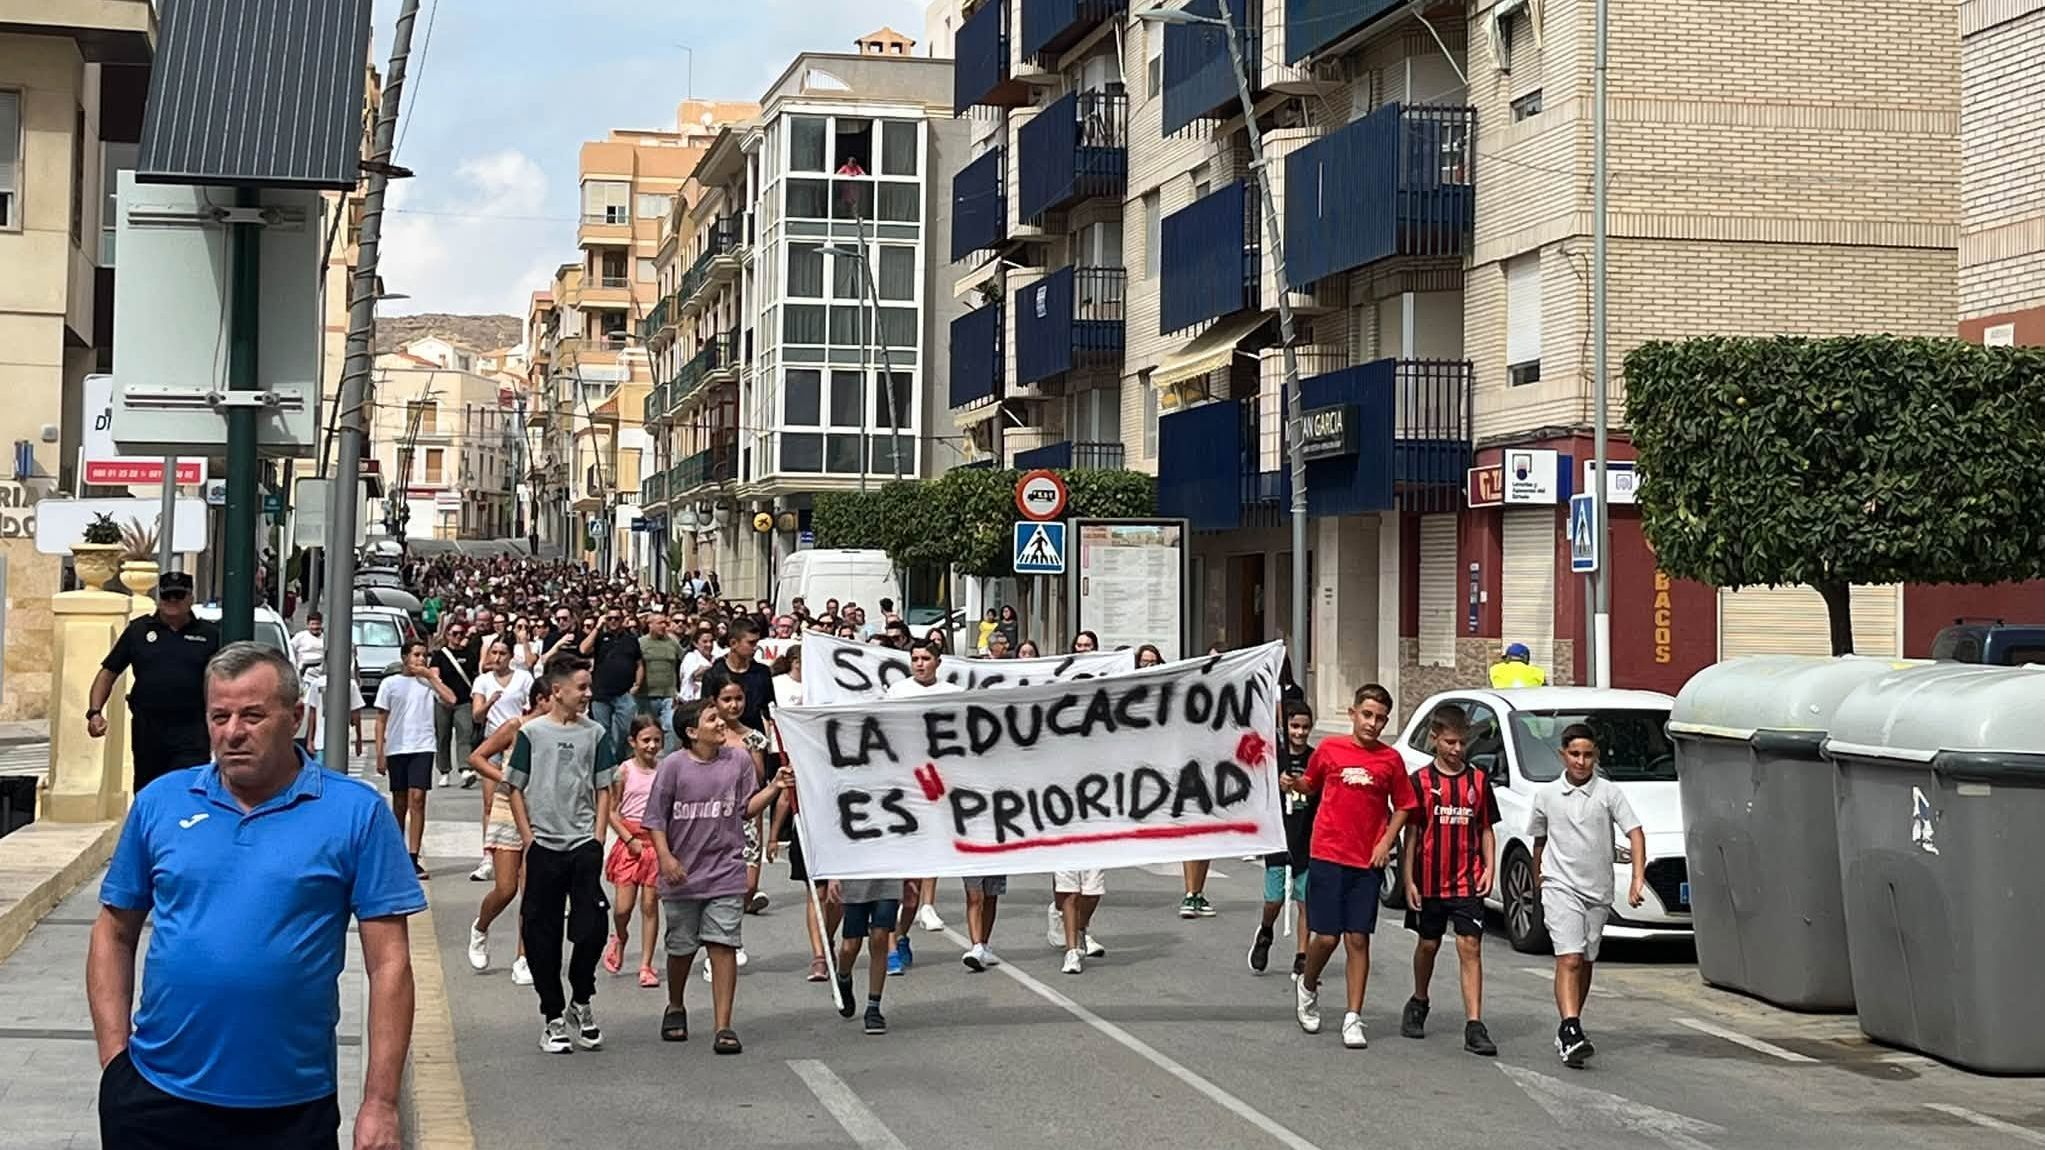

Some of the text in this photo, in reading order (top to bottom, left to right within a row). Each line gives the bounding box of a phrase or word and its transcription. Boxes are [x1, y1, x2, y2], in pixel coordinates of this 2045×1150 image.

[0, 513, 35, 538] DO
[1654, 569, 1671, 663] BACOS
[825, 716, 898, 768] LA
[925, 655, 1272, 759] EDUCACIÓN
[837, 787, 919, 841] ES
